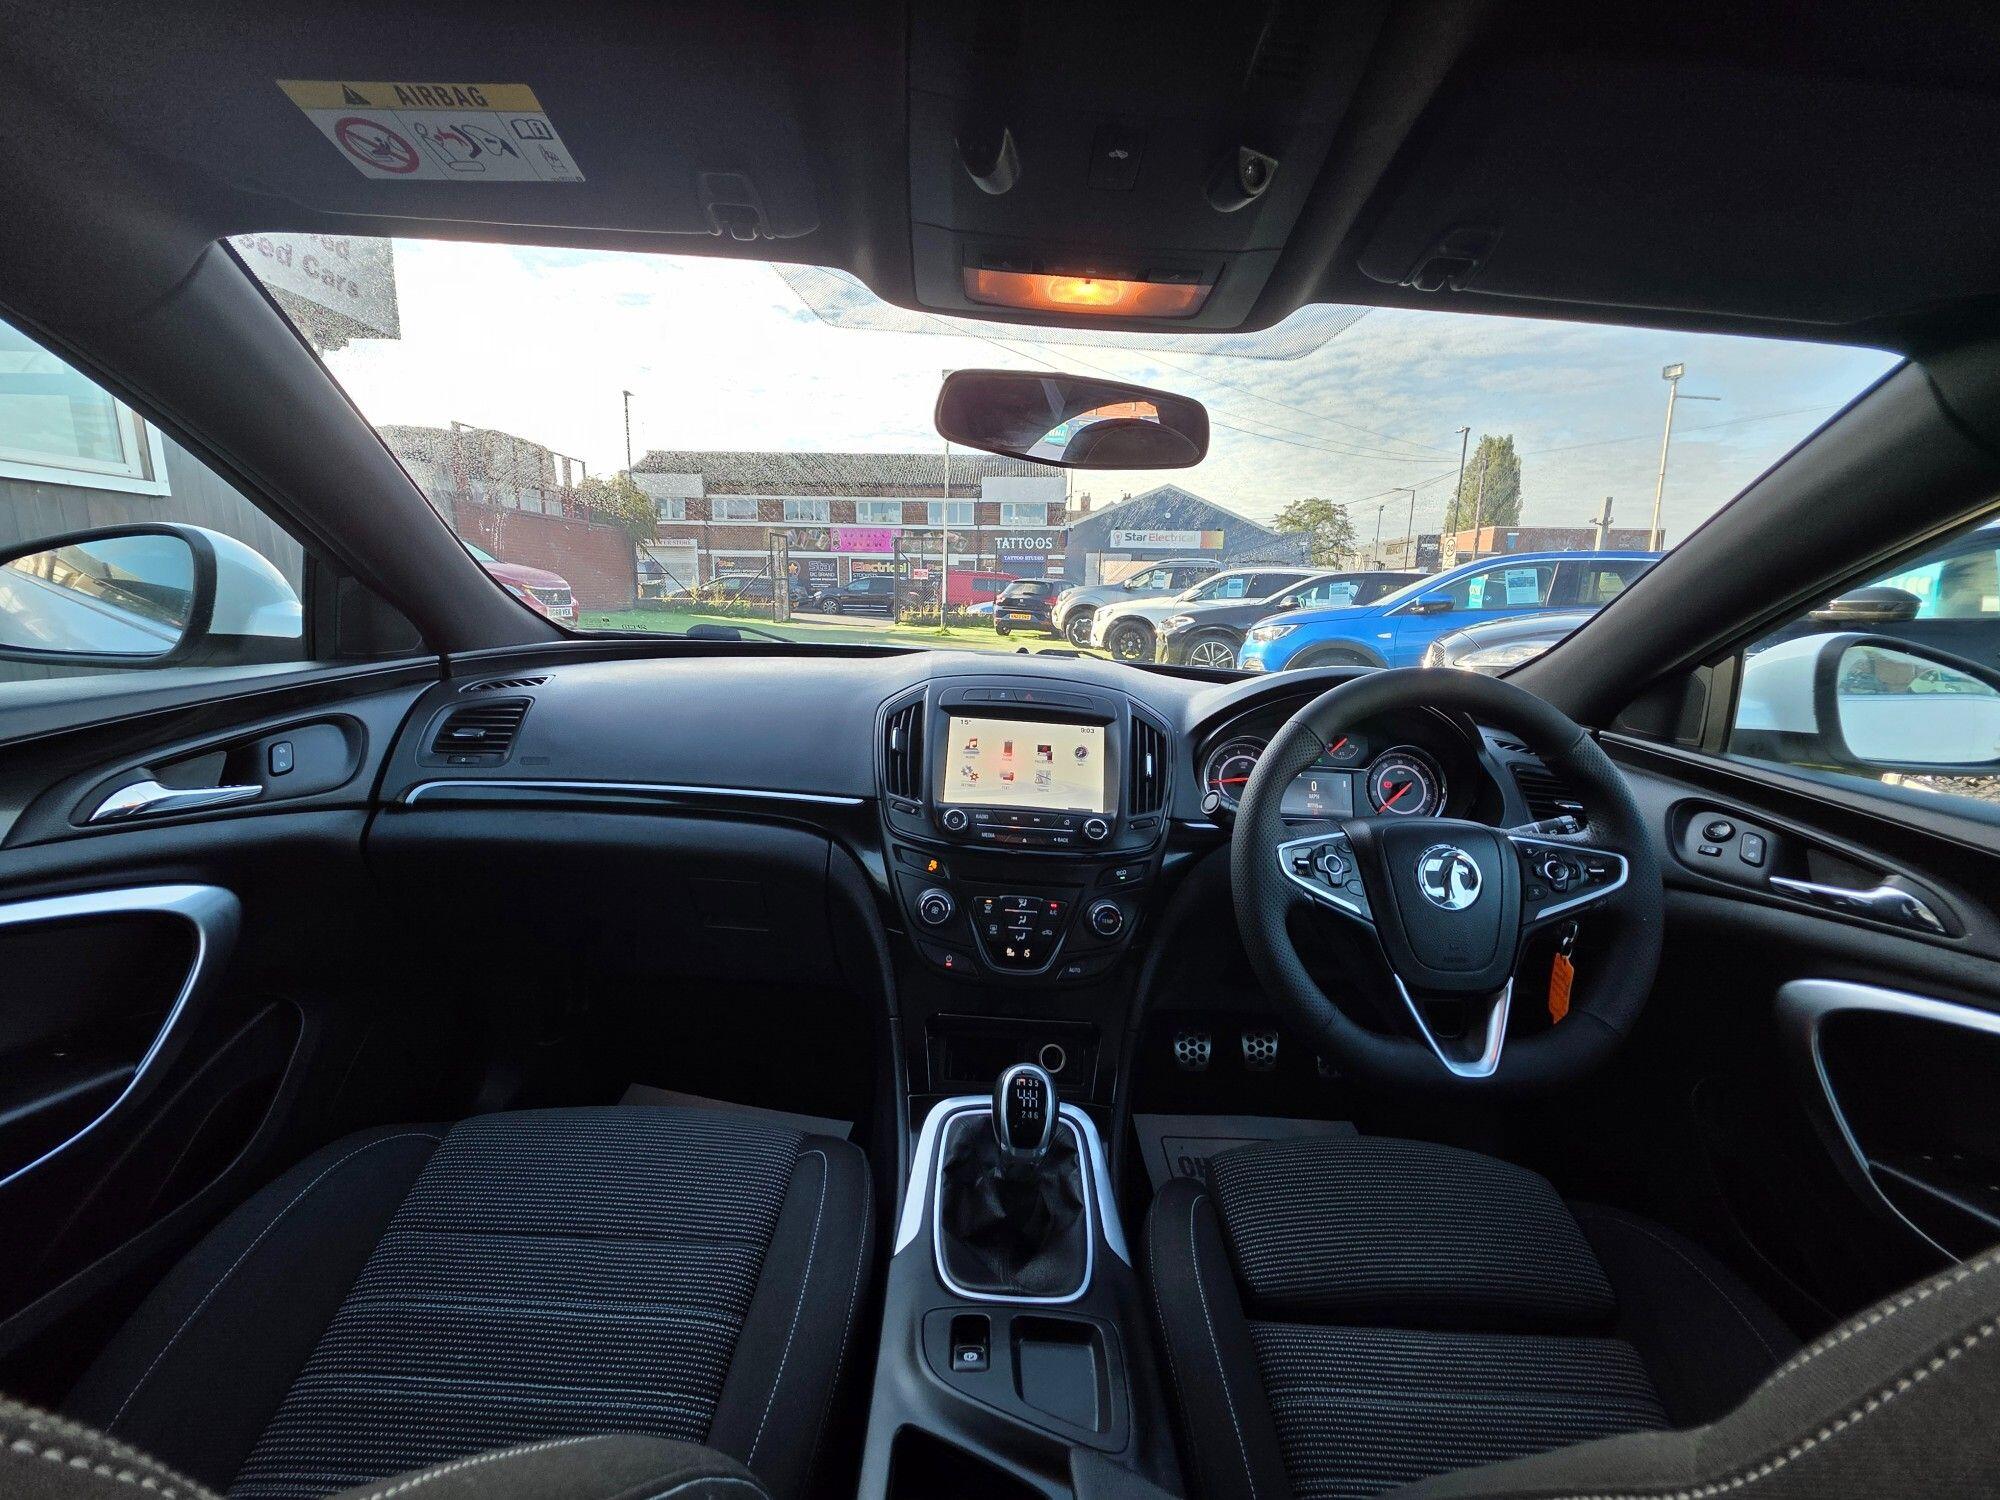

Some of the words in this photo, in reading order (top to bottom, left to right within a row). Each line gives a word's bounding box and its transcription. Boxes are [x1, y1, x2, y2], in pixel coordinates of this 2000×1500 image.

[393, 85, 489, 107] AIRBAG
[302, 254, 360, 299] Cars
[1125, 532, 1147, 542] Star
[1148, 532, 1196, 542] Electrical
[995, 537, 1053, 550] TATTOOS
[808, 560, 835, 572] Star
[1310, 780, 1318, 792] 0
